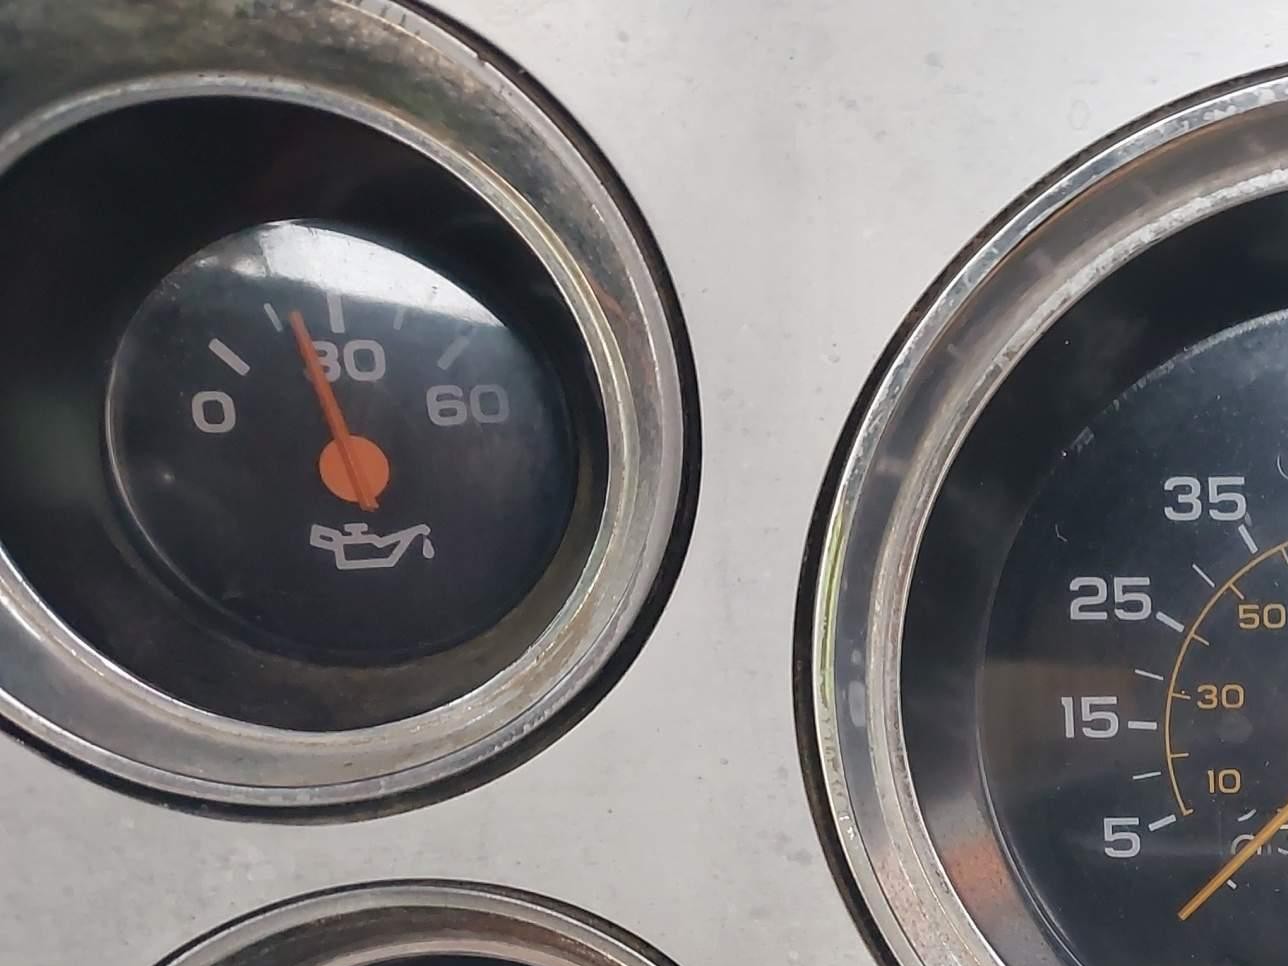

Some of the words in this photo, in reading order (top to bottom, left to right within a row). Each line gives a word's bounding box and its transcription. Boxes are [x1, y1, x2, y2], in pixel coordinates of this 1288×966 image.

[191, 390, 237, 433] 0
[425, 384, 509, 426] 60
[1163, 476, 1248, 521] 35
[1069, 576, 1152, 621] 25
[1238, 603, 1287, 629] 50
[1060, 696, 1120, 739] 15
[1196, 684, 1245, 710] 30
[1206, 768, 1242, 795] 10
[1103, 816, 1141, 858] 5
